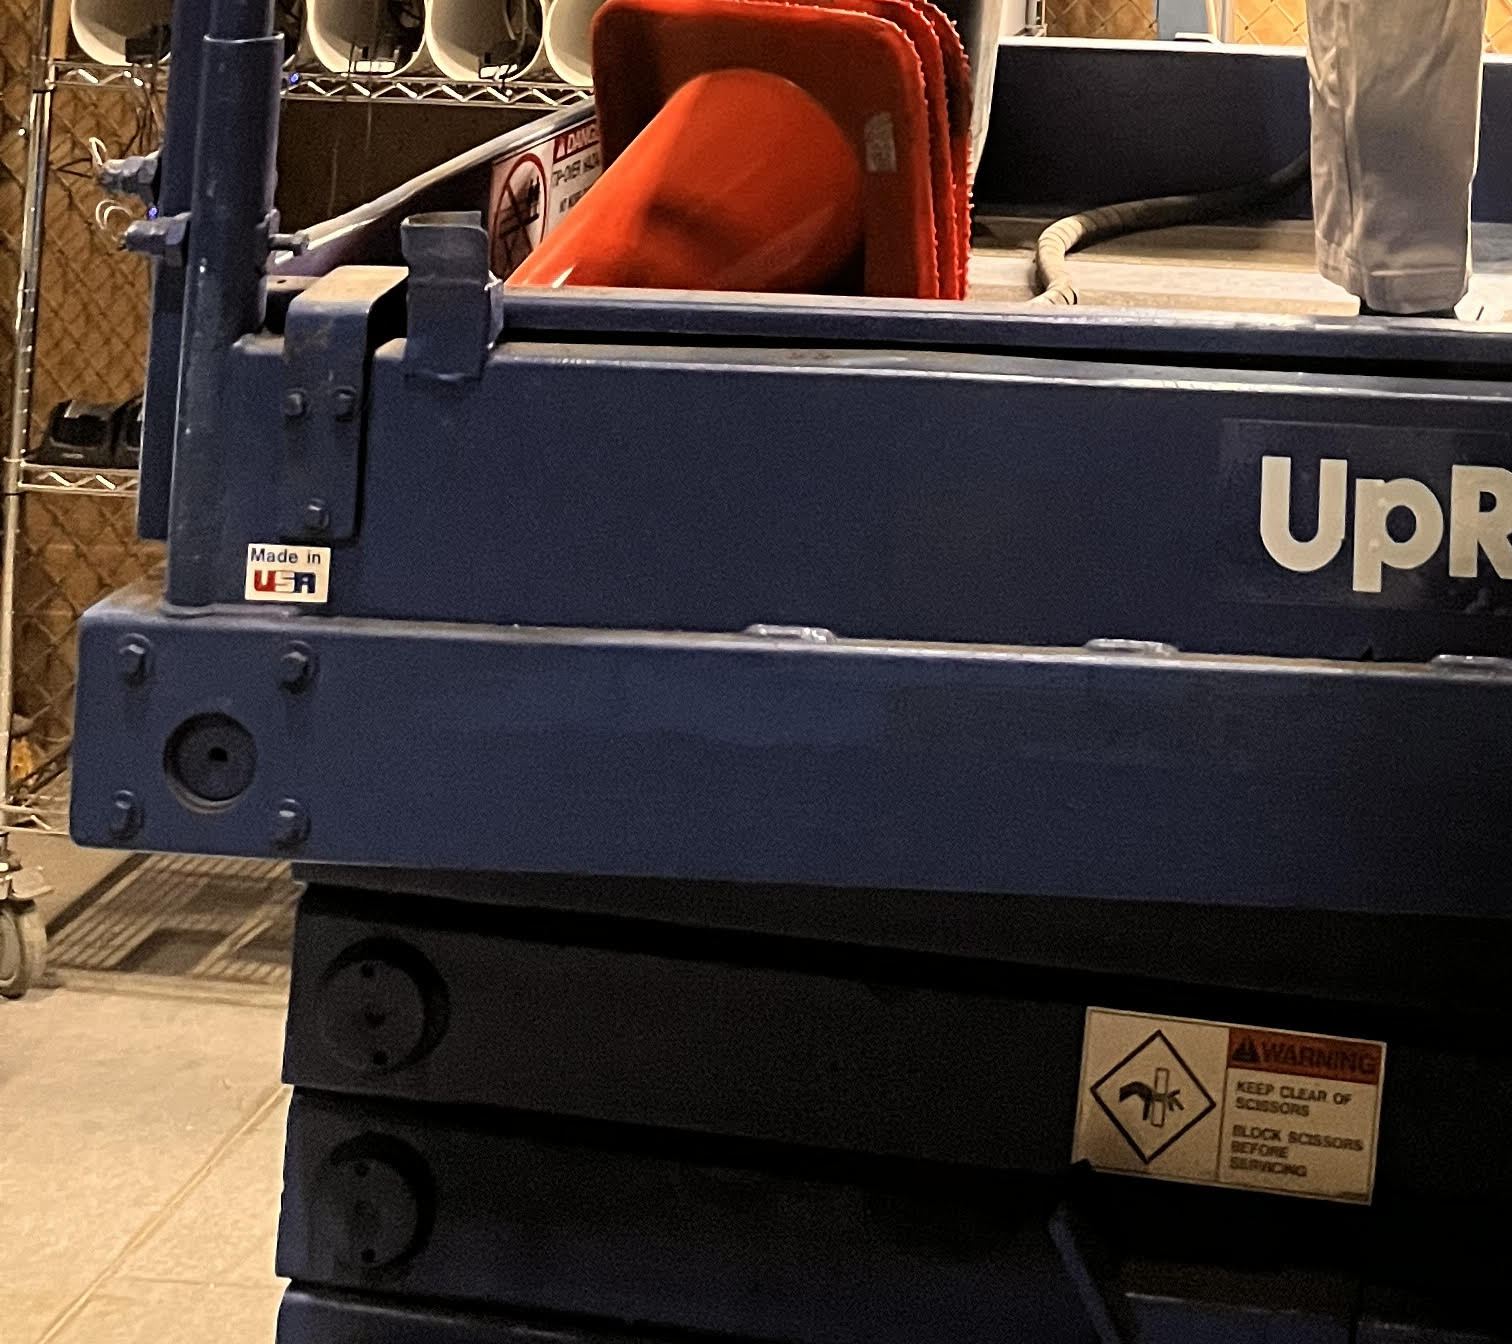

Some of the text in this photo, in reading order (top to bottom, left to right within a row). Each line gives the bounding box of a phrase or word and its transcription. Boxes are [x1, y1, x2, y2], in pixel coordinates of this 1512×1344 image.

[566, 124, 598, 153] DANG
[251, 548, 321, 564] Made in
[254, 570, 316, 594] USA
[1261, 1041, 1376, 1074] WARNING
[1236, 1080, 1353, 1106] KEEP CLEAR OF
[1236, 1096, 1310, 1118] SCISSORS
[1230, 1140, 1289, 1159] BEFORE
[1232, 1124, 1364, 1152] BLOCK SCISSORS
